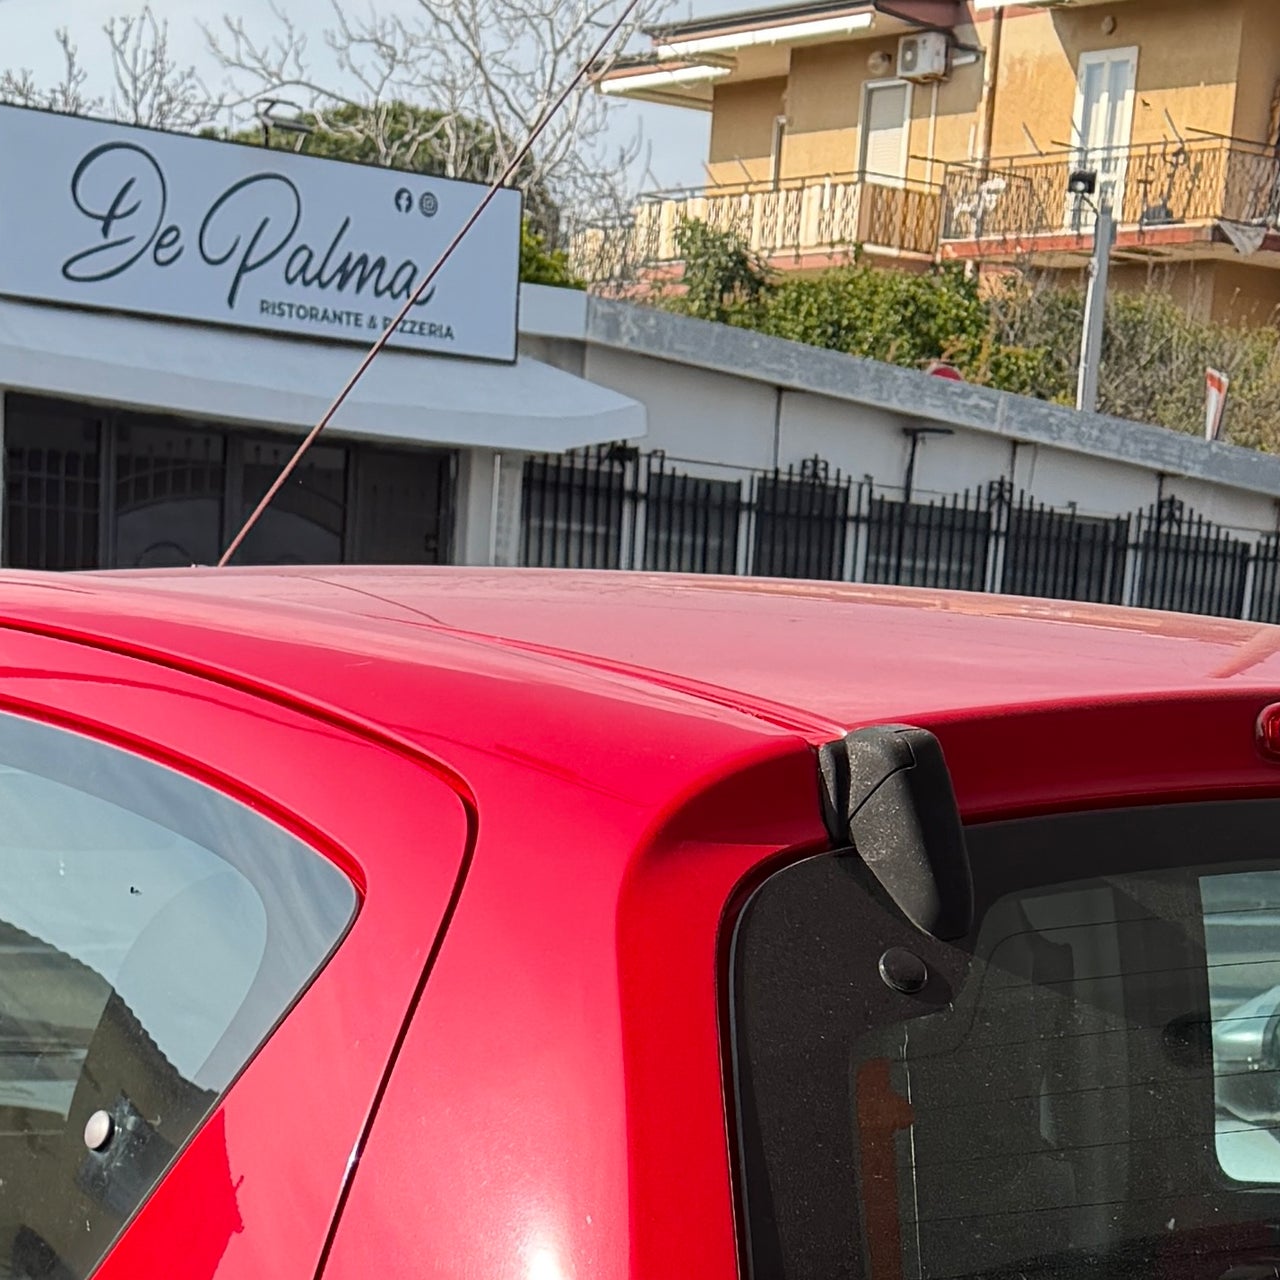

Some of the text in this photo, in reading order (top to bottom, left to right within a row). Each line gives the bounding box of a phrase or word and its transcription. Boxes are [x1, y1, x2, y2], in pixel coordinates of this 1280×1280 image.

[61, 141, 435, 308] De Palma
[259, 299, 365, 330] RISTORANTE
[368, 316, 376, 330] &
